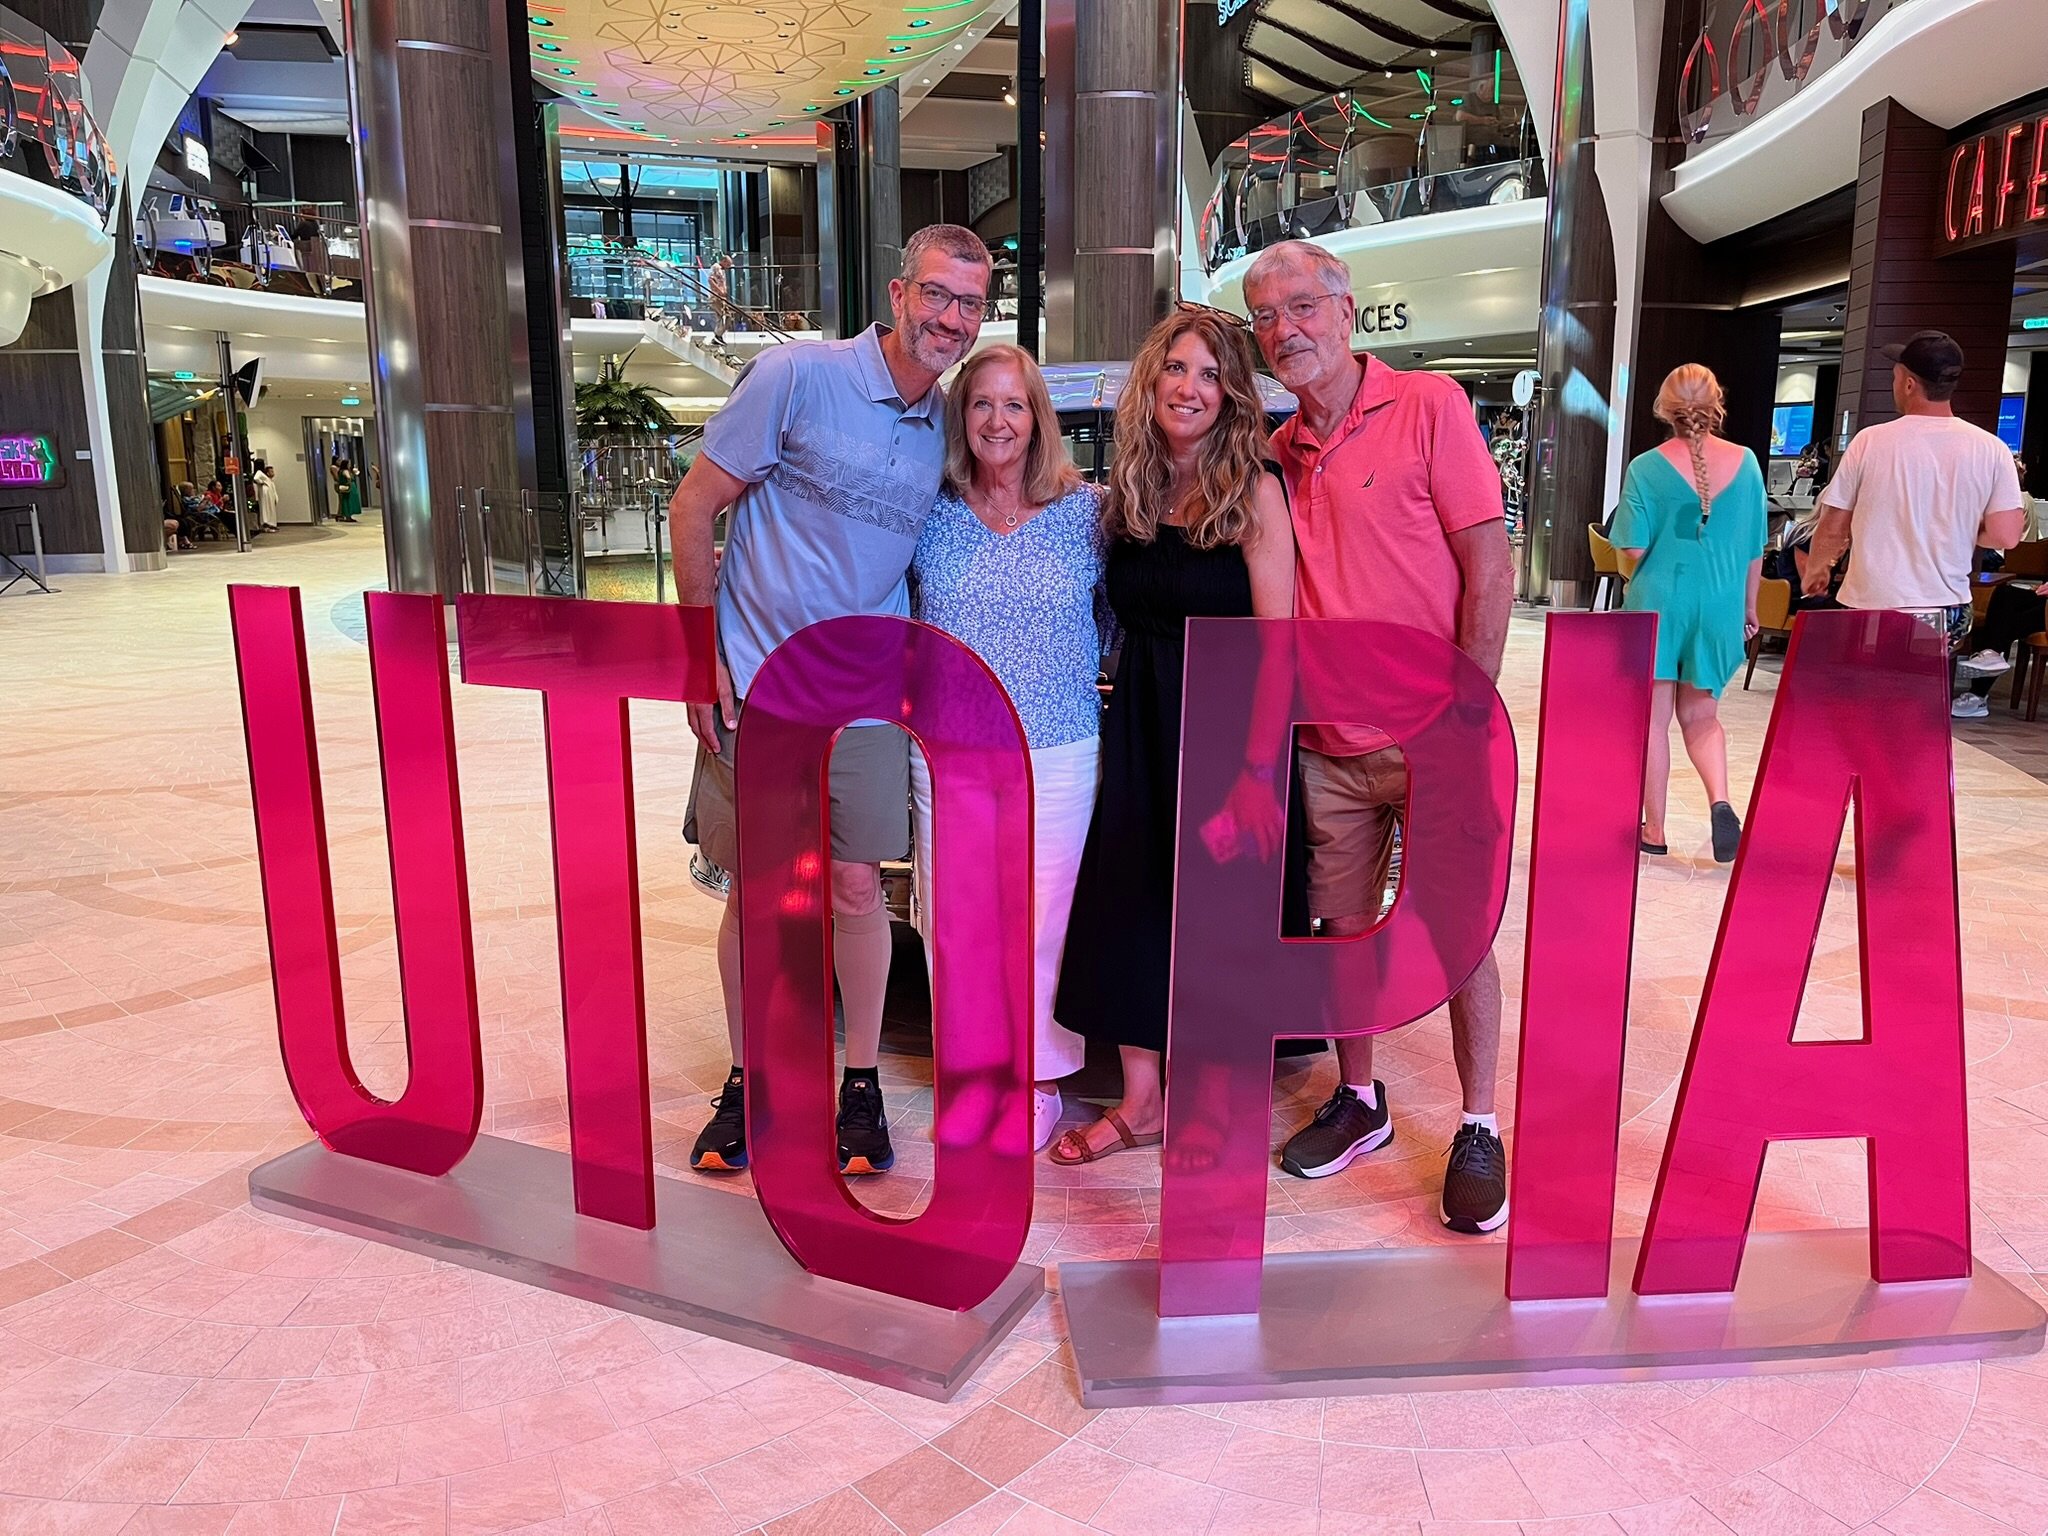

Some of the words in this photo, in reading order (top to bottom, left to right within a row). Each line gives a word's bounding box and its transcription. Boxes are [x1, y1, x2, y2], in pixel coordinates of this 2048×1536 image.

[1945, 114, 2048, 241] CAFE
[1354, 303, 1408, 334] ICES
[228, 584, 1972, 1316] UTOPIA
